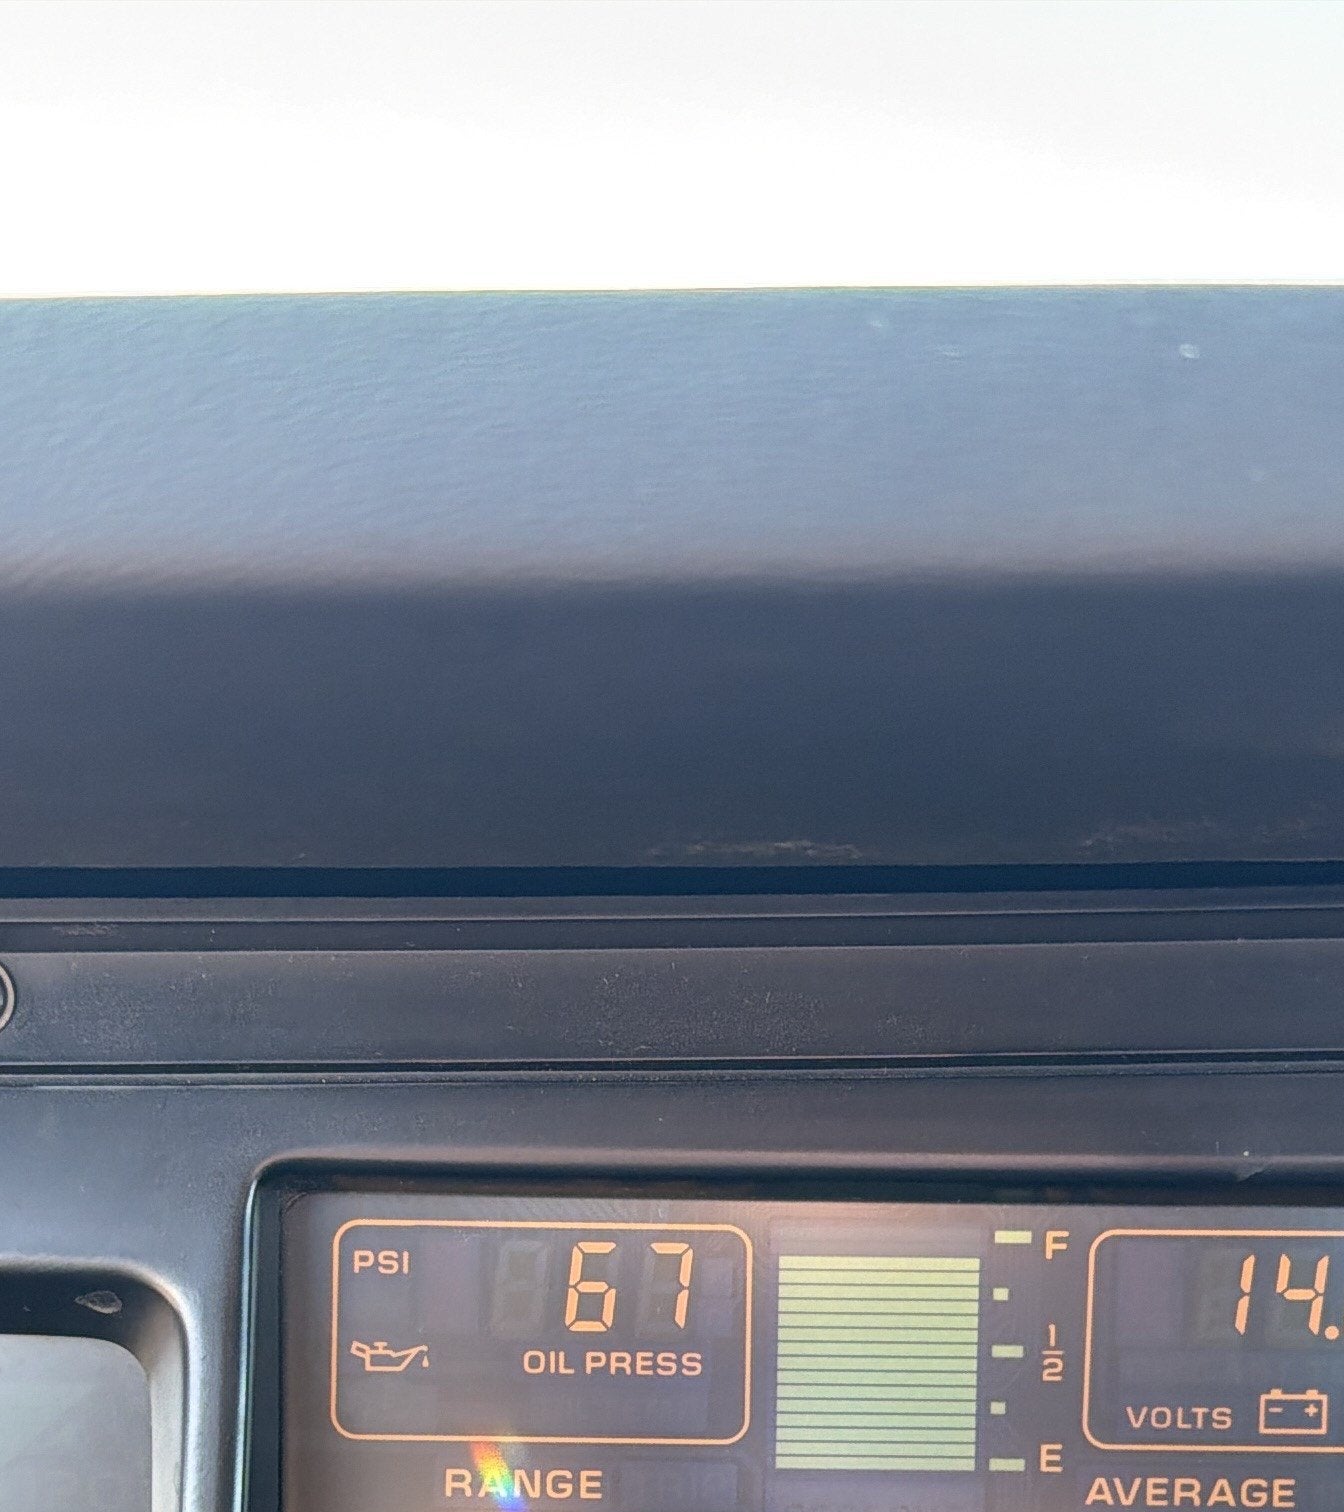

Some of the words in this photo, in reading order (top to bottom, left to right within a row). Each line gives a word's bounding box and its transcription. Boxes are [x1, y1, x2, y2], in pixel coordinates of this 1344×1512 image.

[1045, 1230, 1069, 1259] F
[353, 1250, 409, 1274] PSI
[565, 1242, 693, 1332] 67
[523, 1350, 574, 1374] OIL
[585, 1351, 701, 1375] PRESS
[1126, 1407, 1232, 1429] VOLTS
[1040, 1444, 1062, 1472] E
[444, 1468, 603, 1499] RANGE
[1085, 1477, 1295, 1507] AVERAGE
